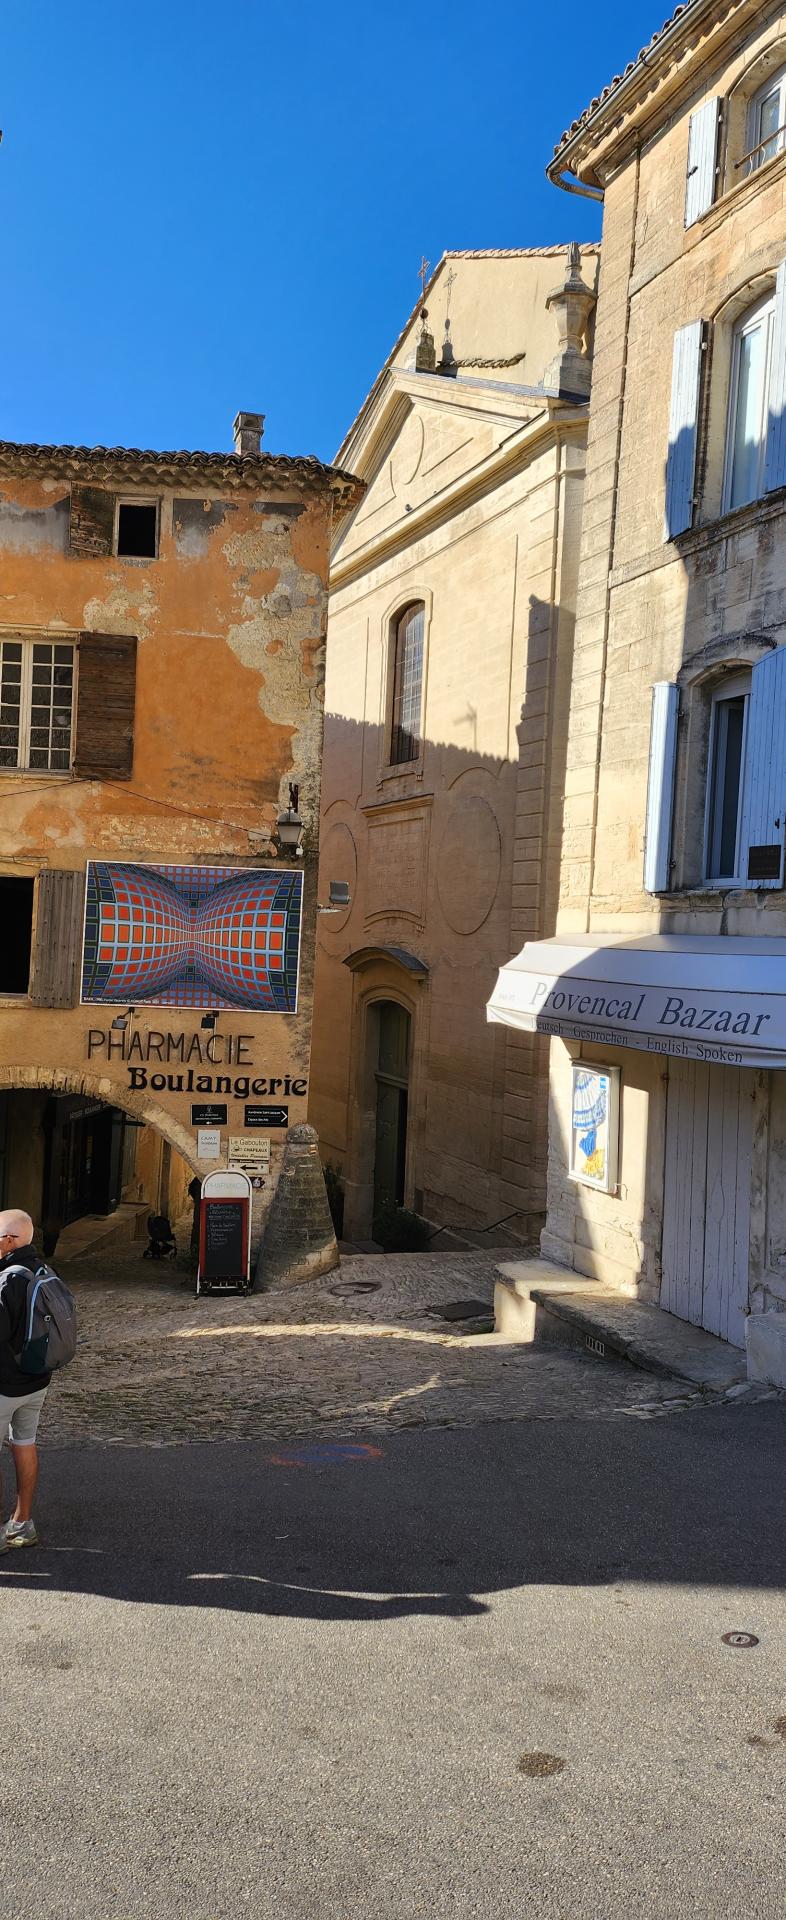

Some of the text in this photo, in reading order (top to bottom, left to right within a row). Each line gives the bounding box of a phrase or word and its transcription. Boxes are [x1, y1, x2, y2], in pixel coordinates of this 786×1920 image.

[529, 981, 771, 1036] Provencal Bazaar
[87, 1030, 255, 1065] PHARMACIE
[573, 1025, 628, 1046] Gesprochen
[647, 1036, 689, 1056] English
[696, 1042, 743, 1064] Spoken
[127, 1067, 308, 1099] Boulangerie
